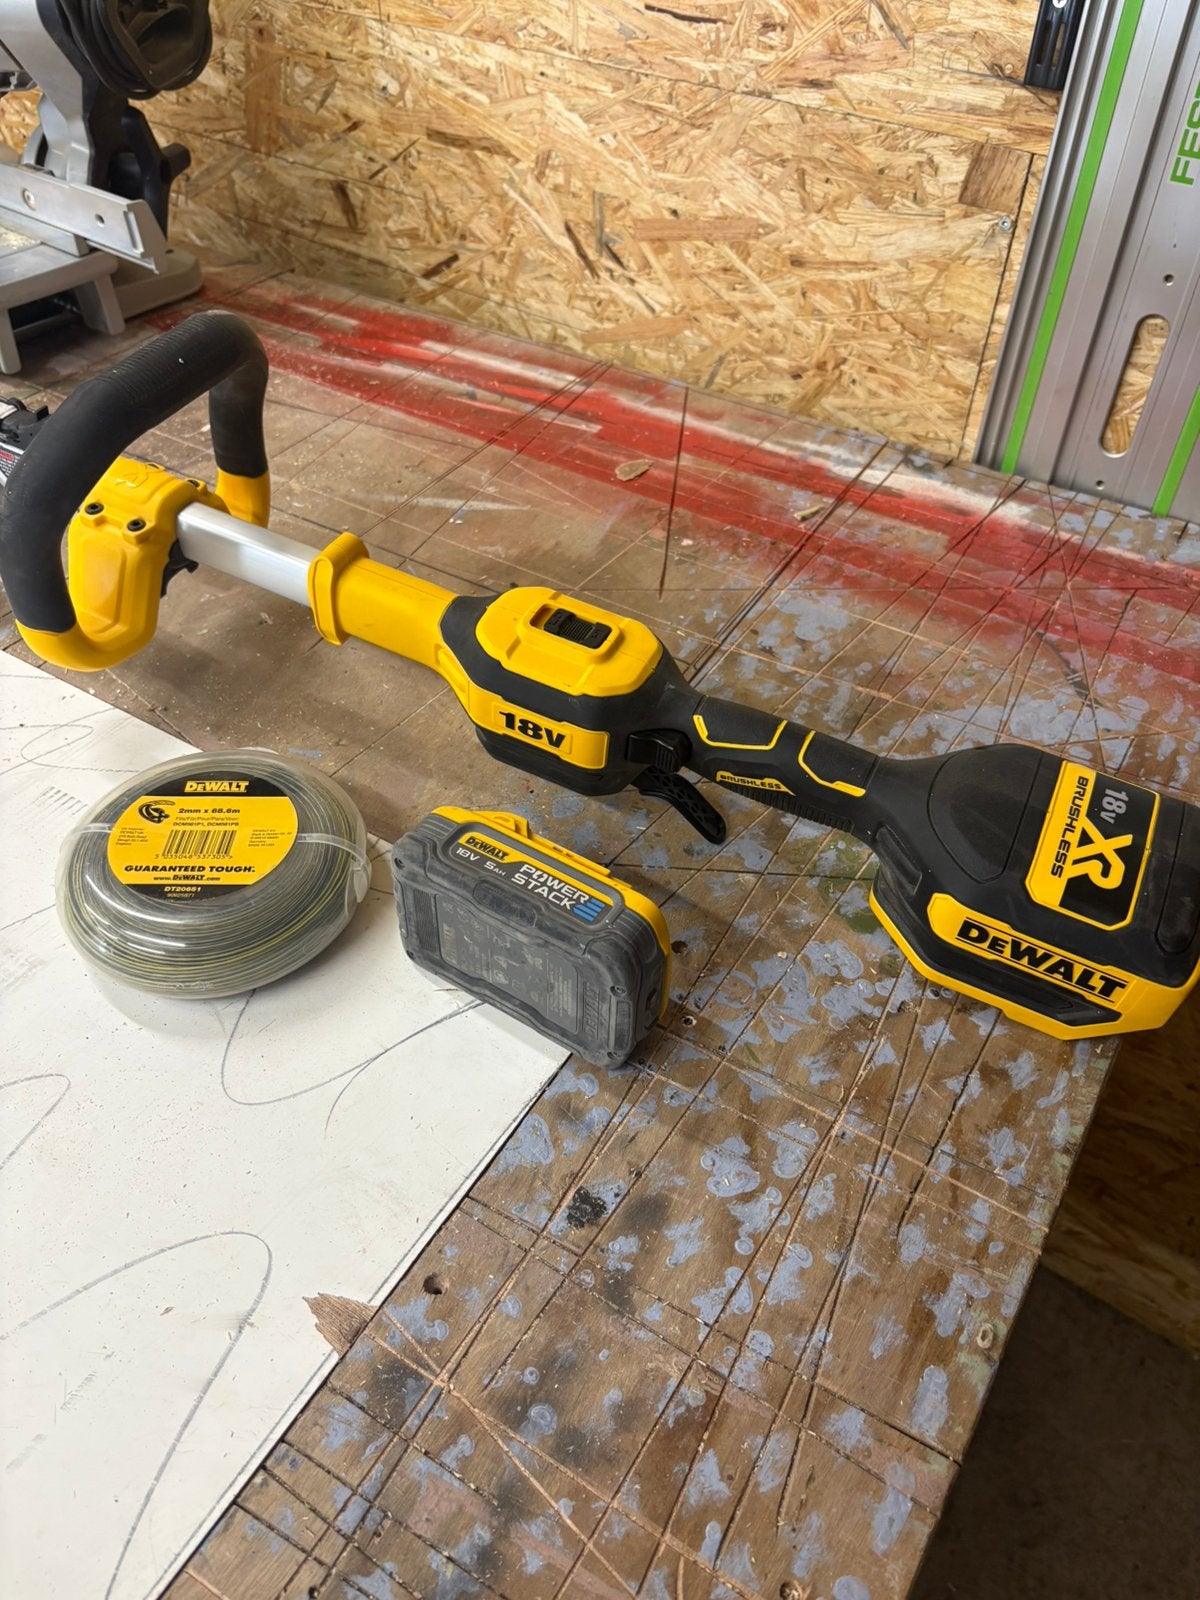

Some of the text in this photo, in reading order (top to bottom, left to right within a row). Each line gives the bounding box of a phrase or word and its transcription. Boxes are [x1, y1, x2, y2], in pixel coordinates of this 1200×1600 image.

[1170, 80, 1200, 186] FES
[498, 710, 568, 749] 18V
[720, 774, 782, 790] BRUSHLESS
[1050, 775, 1089, 879] BRUSHLESS
[124, 865, 206, 873] GUARANTEED
[456, 847, 481, 861] 18V
[1071, 815, 1133, 890] XR
[511, 873, 578, 910] STACK
[519, 864, 590, 904] POWER
[956, 919, 1127, 999] DEWALT
